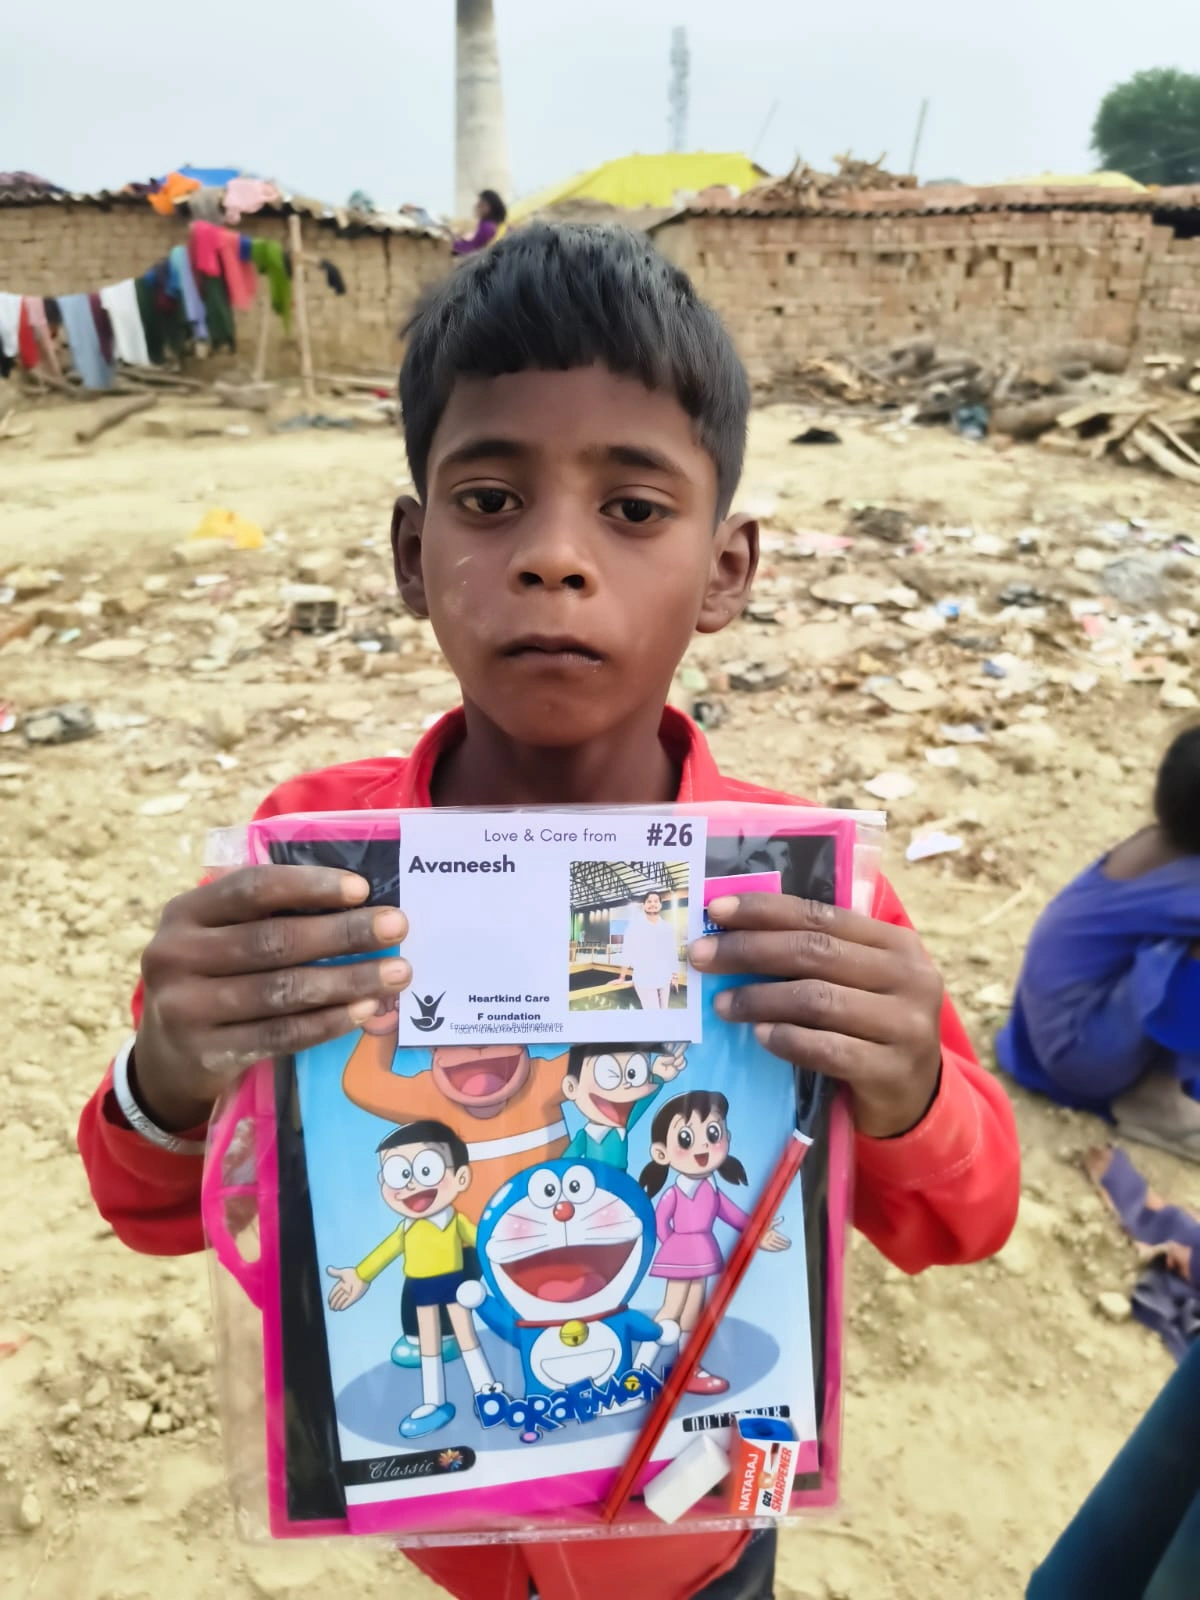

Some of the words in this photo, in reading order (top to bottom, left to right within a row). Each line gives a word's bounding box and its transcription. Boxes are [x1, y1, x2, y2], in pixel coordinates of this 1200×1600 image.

[484, 829, 518, 842] Love
[524, 829, 535, 842] &
[540, 829, 577, 842] Care
[583, 828, 617, 842] from
[646, 823, 693, 847] #26
[408, 854, 516, 873] Avaneesh
[468, 994, 522, 1003] Heartkind
[525, 994, 550, 1002] Care
[368, 1457, 435, 1480] Classic
[770, 1446, 792, 1513] SHARPENER
[738, 1453, 759, 1511] NATARAJ
